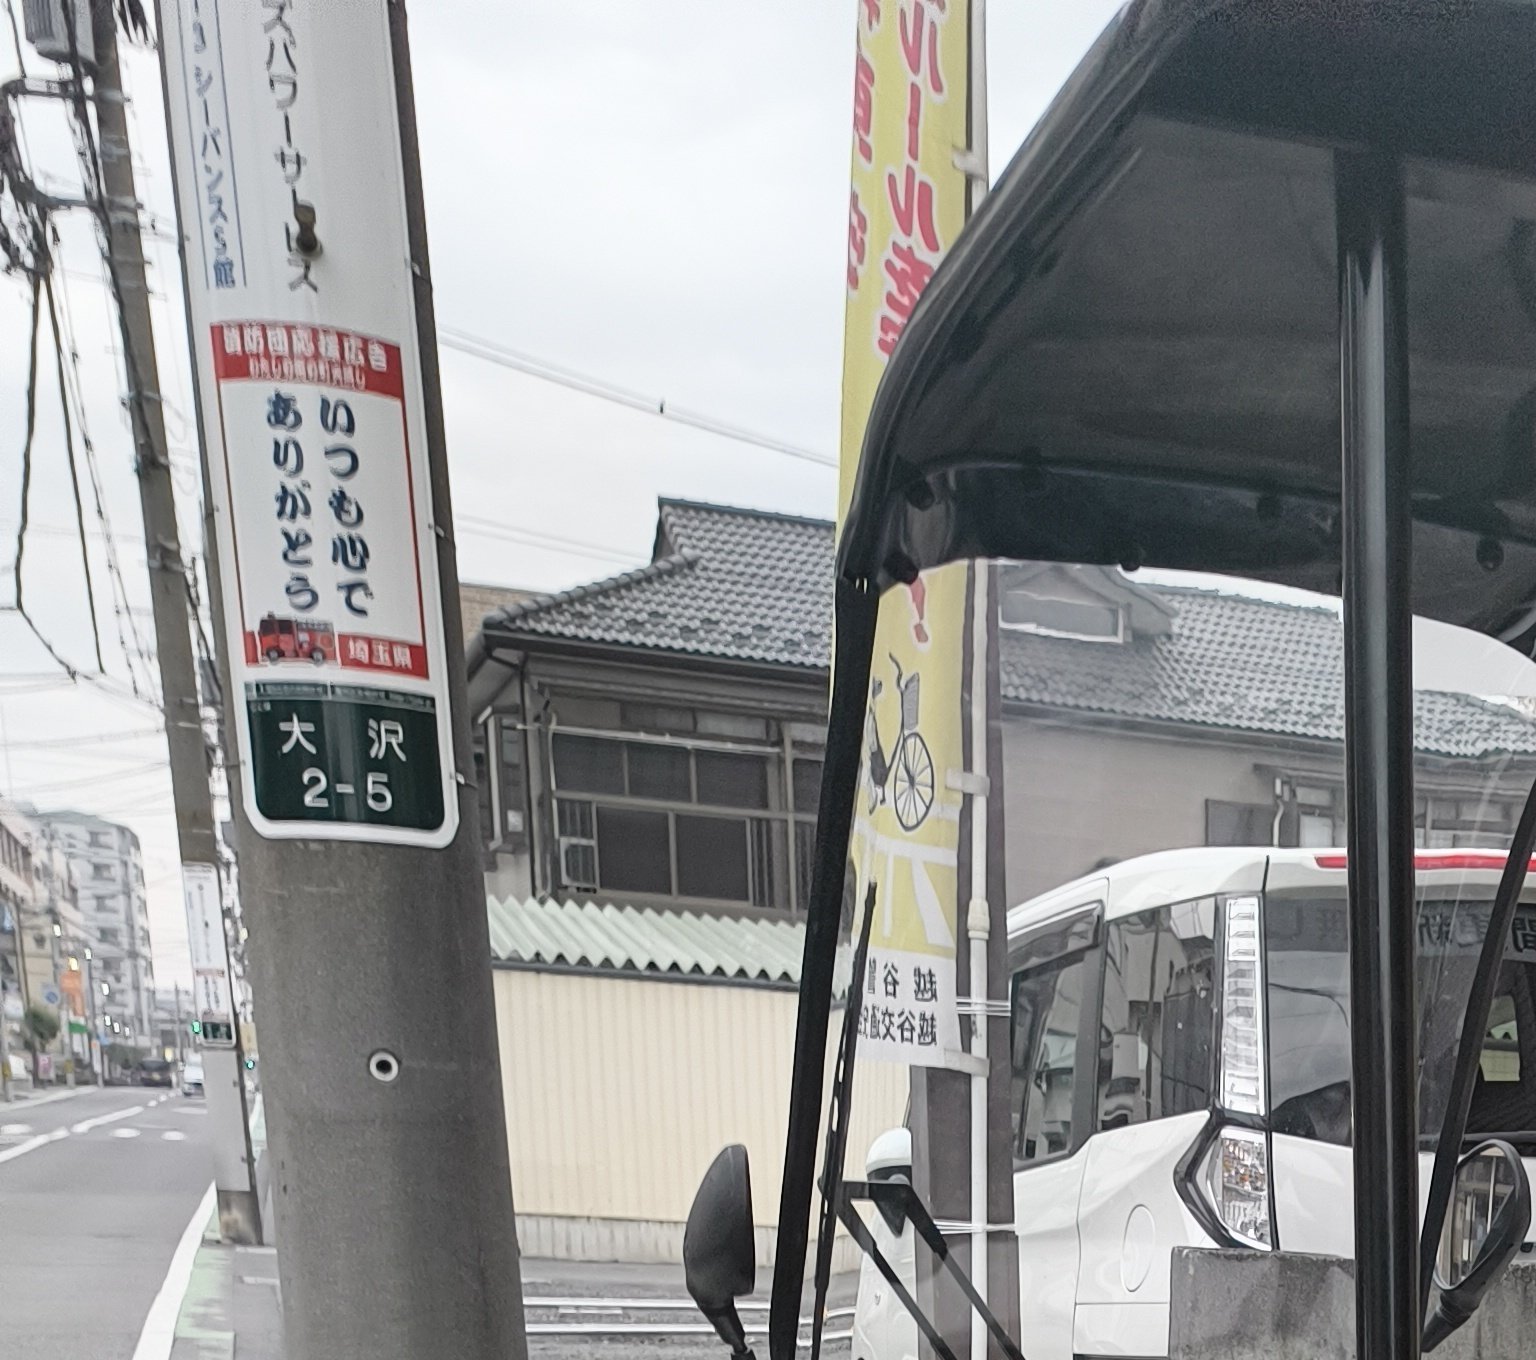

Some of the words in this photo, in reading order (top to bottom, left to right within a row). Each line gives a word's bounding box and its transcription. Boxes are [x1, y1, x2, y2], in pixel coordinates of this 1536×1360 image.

[266, 388, 320, 613] ありがとう
[319, 393, 375, 617] いつも心で
[349, 637, 413, 670] 埼玉県
[302, 767, 393, 812] 2-5
